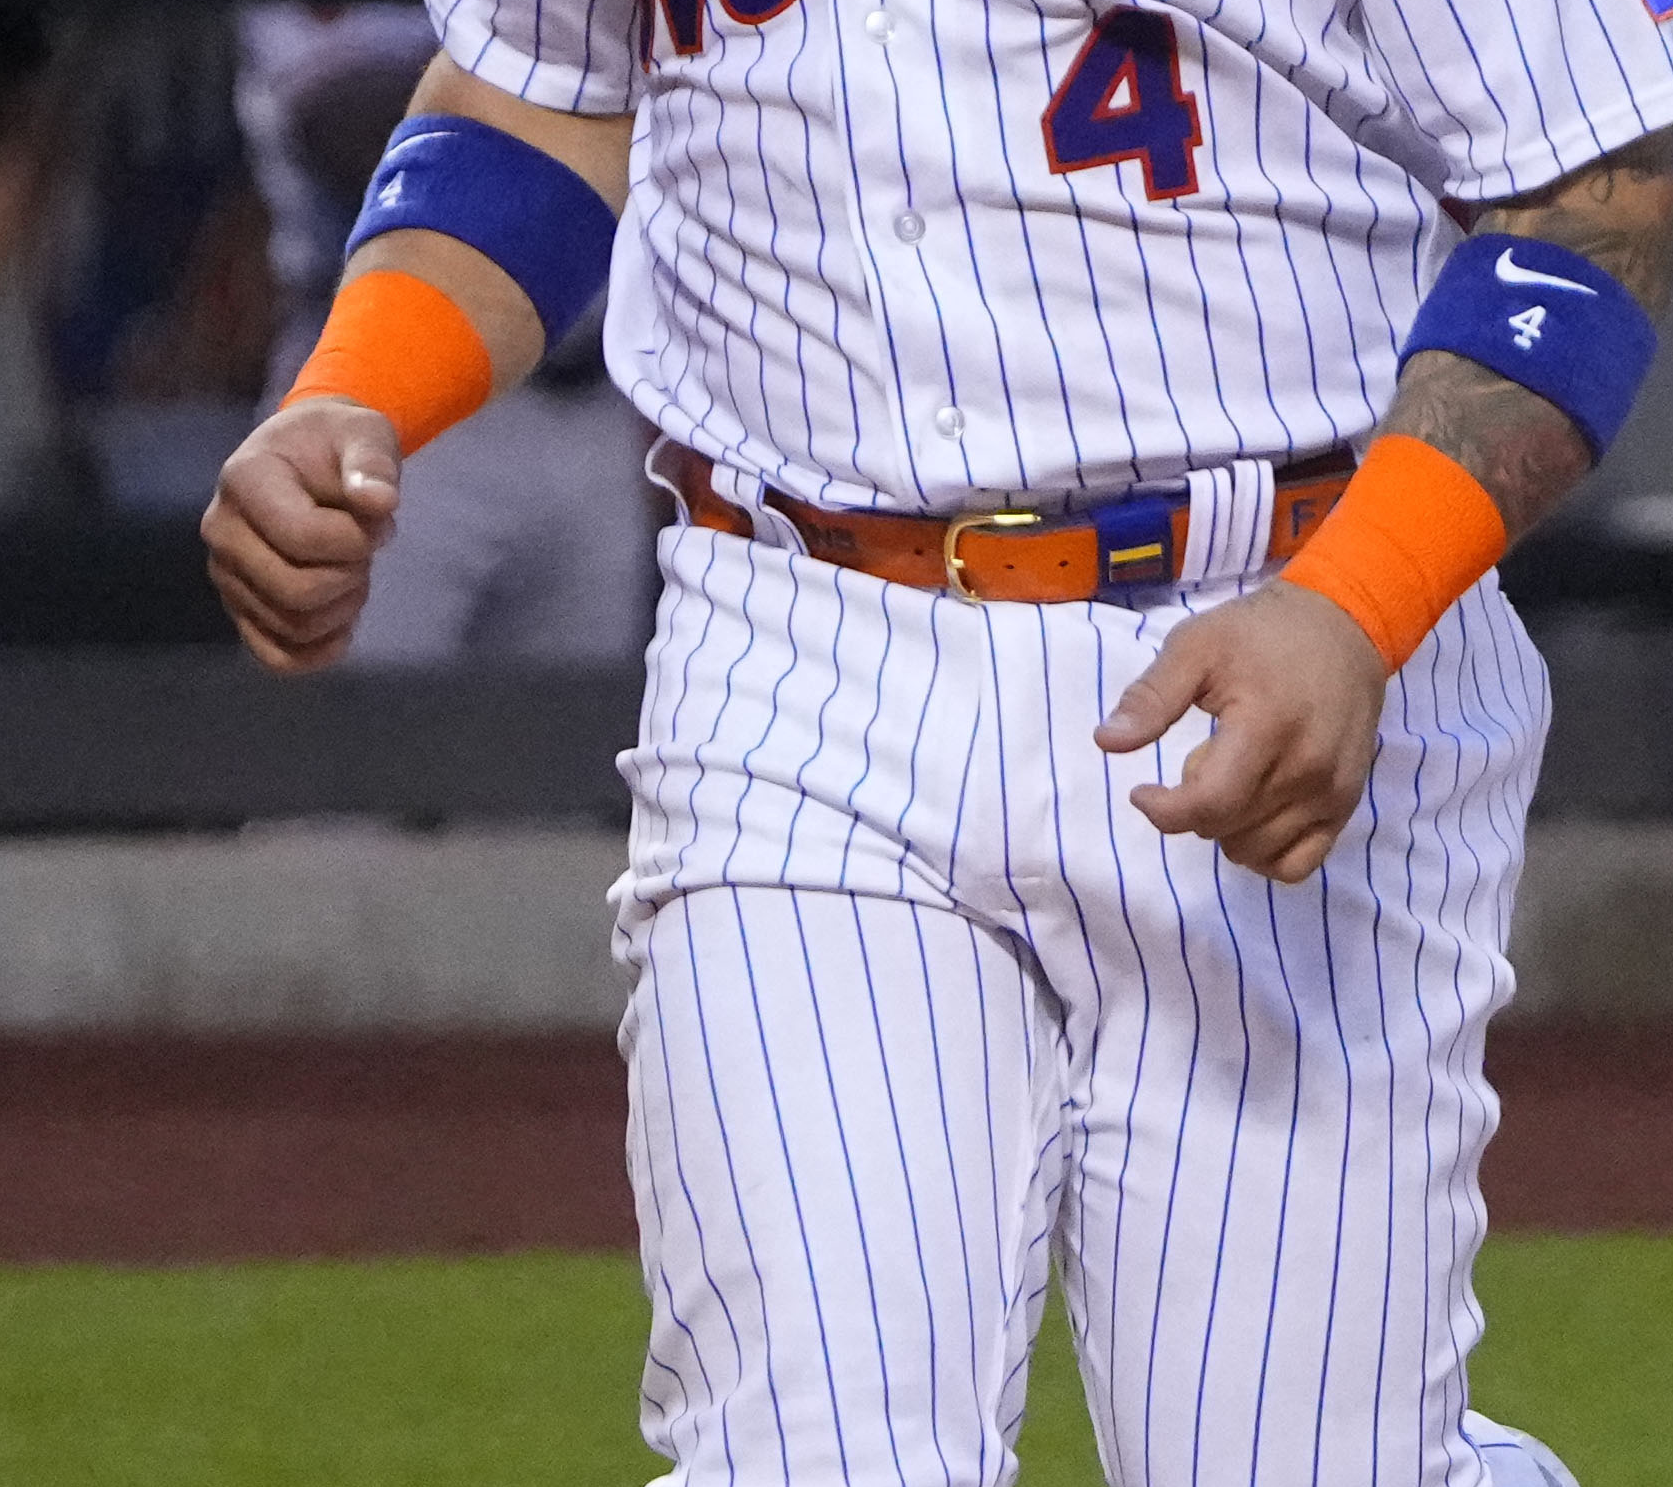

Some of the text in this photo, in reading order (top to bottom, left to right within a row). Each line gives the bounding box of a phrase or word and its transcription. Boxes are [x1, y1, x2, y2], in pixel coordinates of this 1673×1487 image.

[1041, 4, 1203, 201] 4
[378, 170, 406, 208] 4
[1508, 305, 1547, 350] 4
